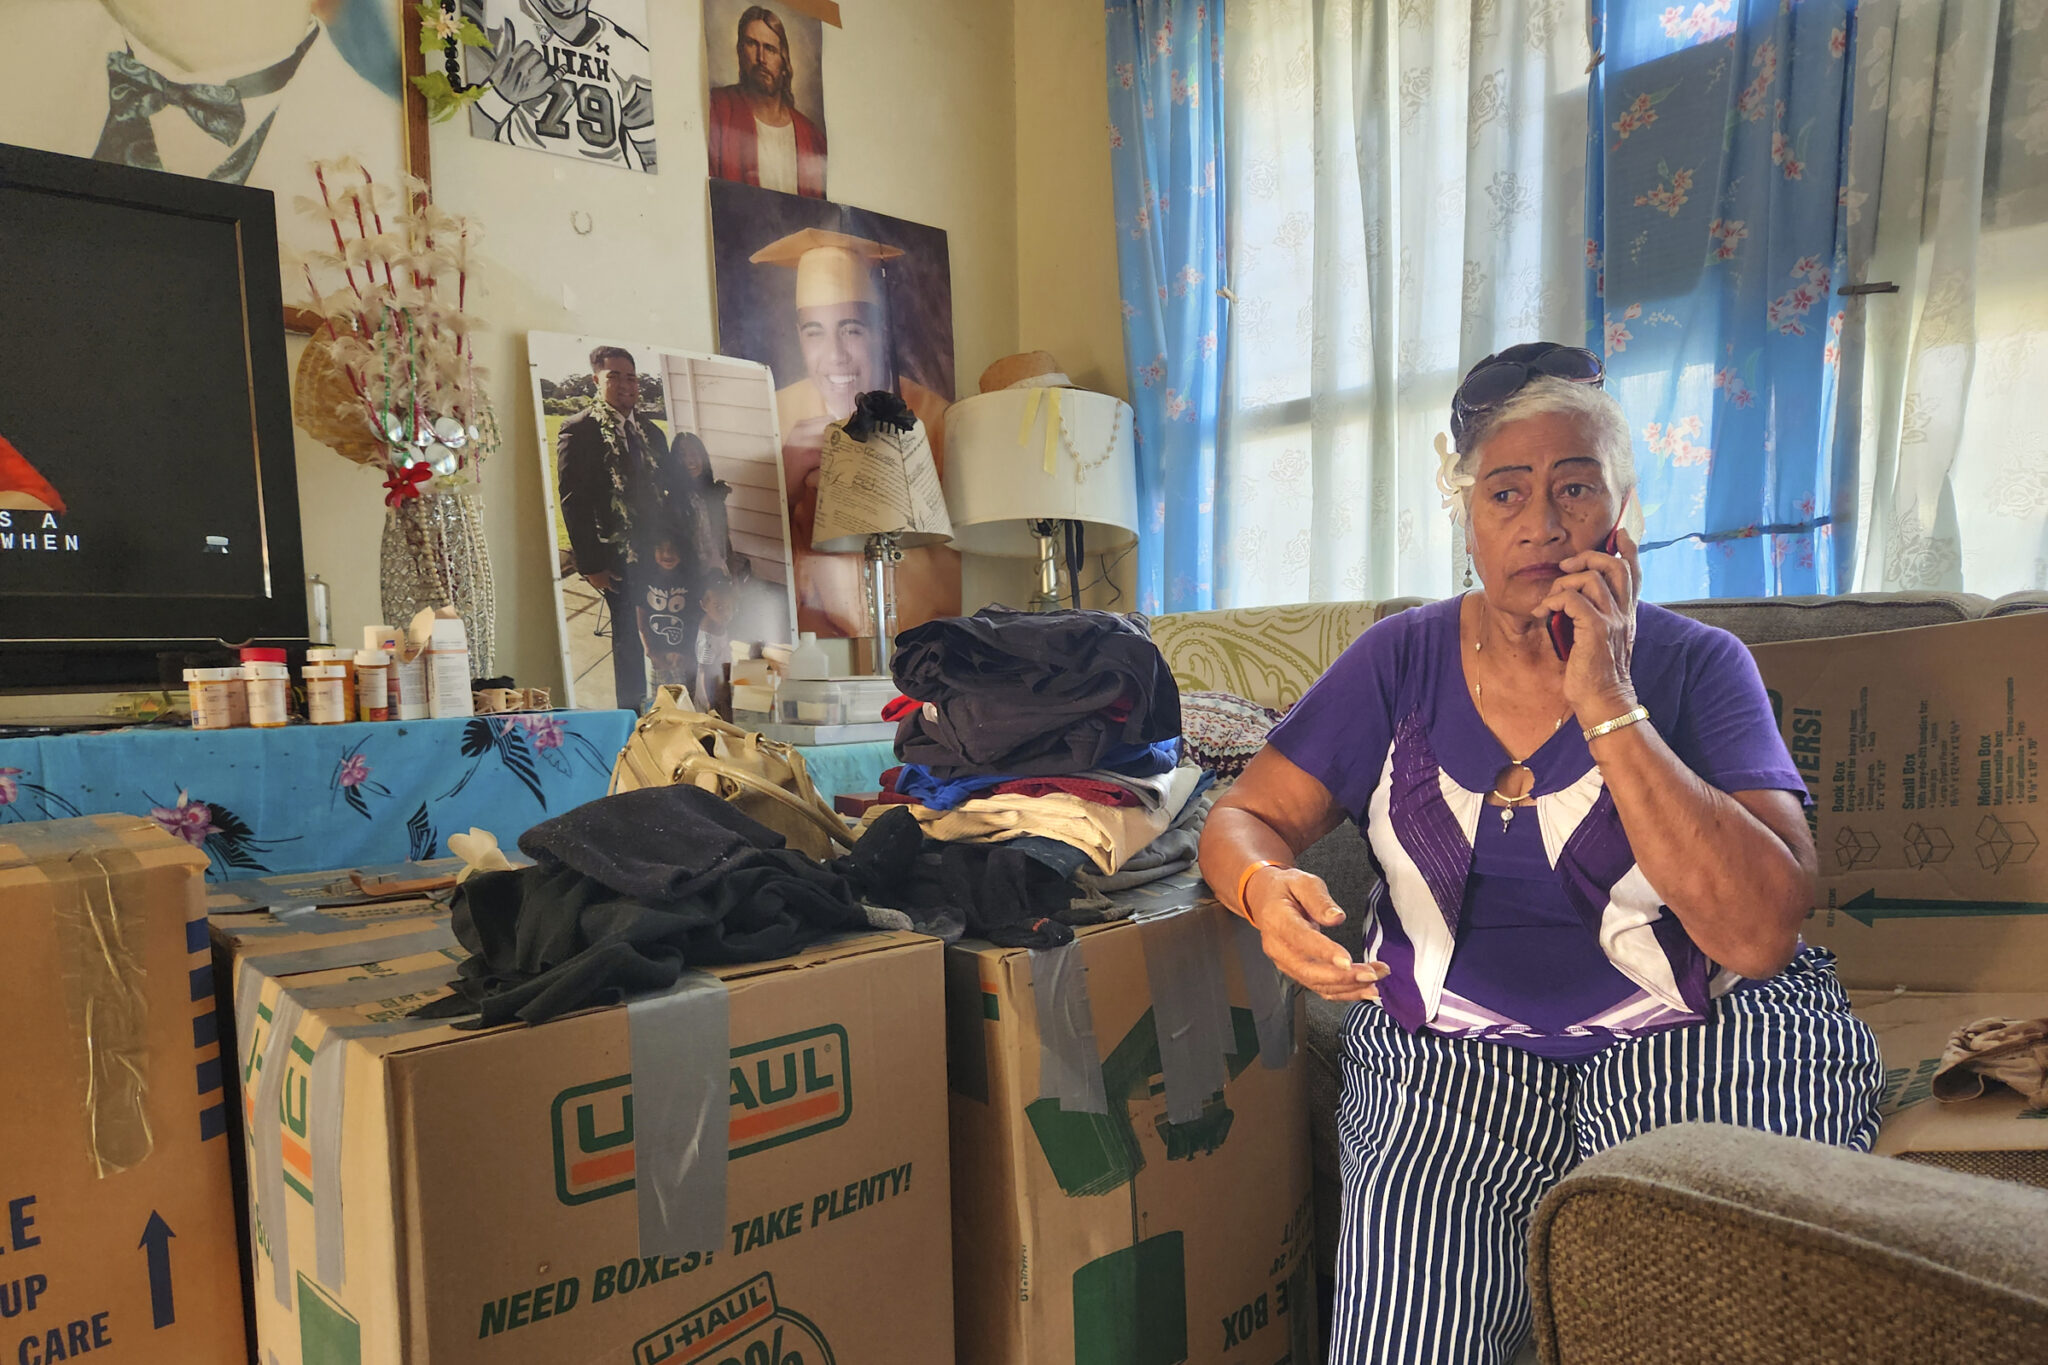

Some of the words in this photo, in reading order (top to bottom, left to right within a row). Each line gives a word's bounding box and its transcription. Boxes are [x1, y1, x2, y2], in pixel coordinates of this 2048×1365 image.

[541, 44, 611, 83] UTAH
[0, 533, 79, 551] WHEN
[1903, 753, 1915, 775] Box
[1978, 735, 1991, 757] Box
[1832, 761, 1846, 782] Box
[1977, 760, 1991, 807] Medium
[1831, 785, 1845, 812] Book
[1902, 778, 1915, 810] Small
[576, 1046, 835, 1155] UAUL
[478, 1276, 580, 1341] NEED
[731, 1203, 803, 1256] TAKE
[811, 1162, 913, 1229] PLENTY!
[0, 1273, 48, 1319] UP
[18, 1310, 113, 1365] CARE
[644, 1285, 768, 1365] U-HAUL
[1221, 1291, 1269, 1353] BOX
